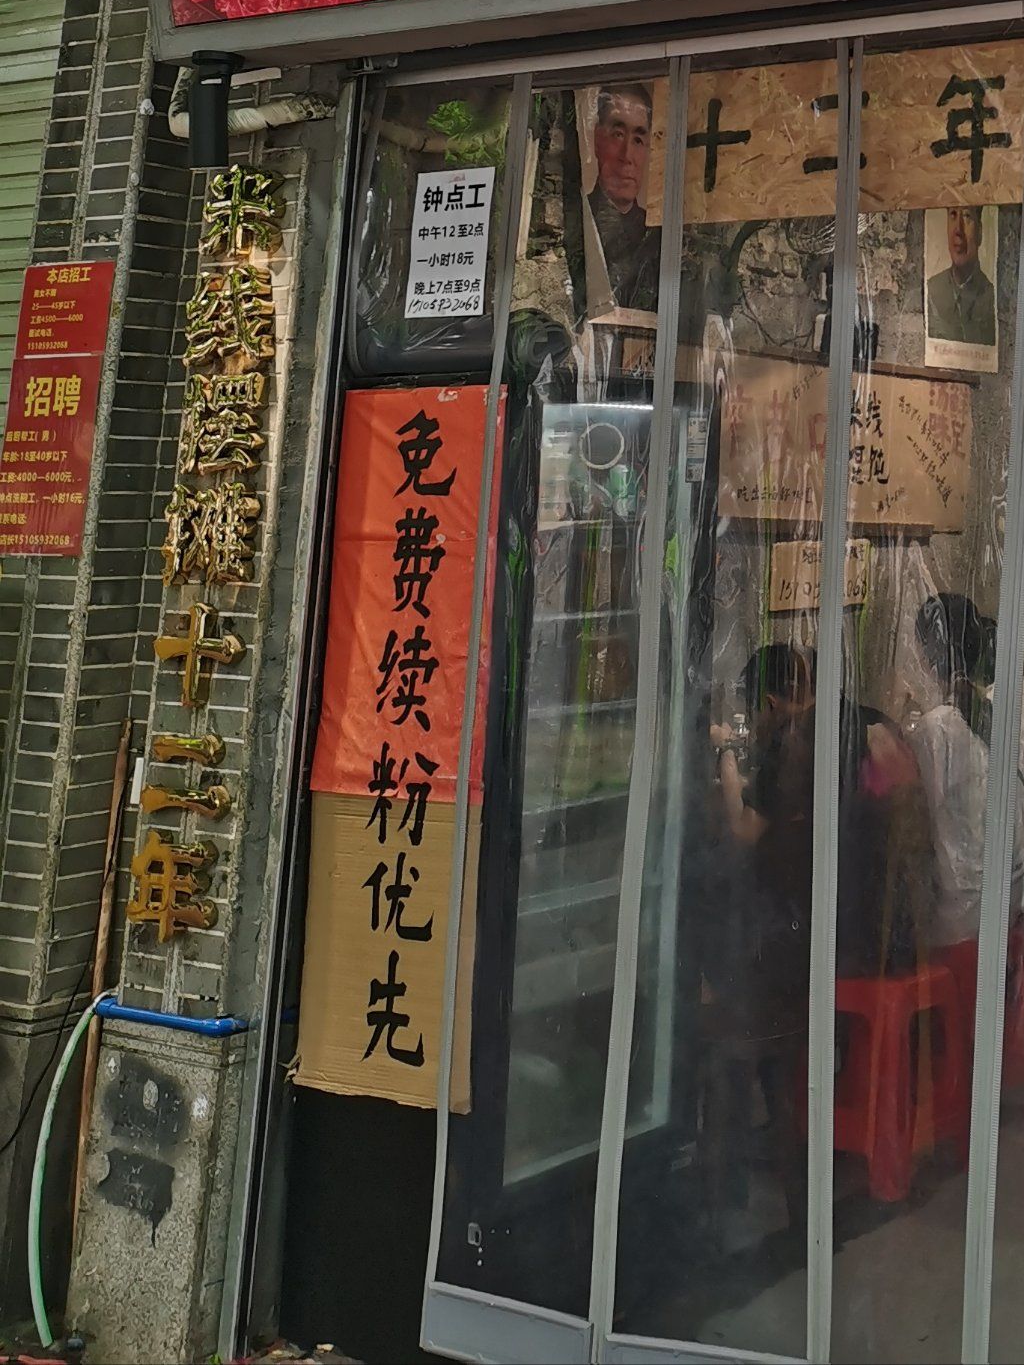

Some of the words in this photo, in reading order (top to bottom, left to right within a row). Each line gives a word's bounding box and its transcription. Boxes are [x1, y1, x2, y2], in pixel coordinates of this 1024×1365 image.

[422, 183, 487, 213] 钟点工
[416, 251, 474, 267] 一小时18元
[46, 266, 92, 284] 本店招工
[414, 278, 482, 296] 晚上7点至9点
[24, 374, 82, 418] 招聘
[127, 164, 285, 945] 米线摆摊十二年
[360, 408, 458, 1069] 免费续粉优先
